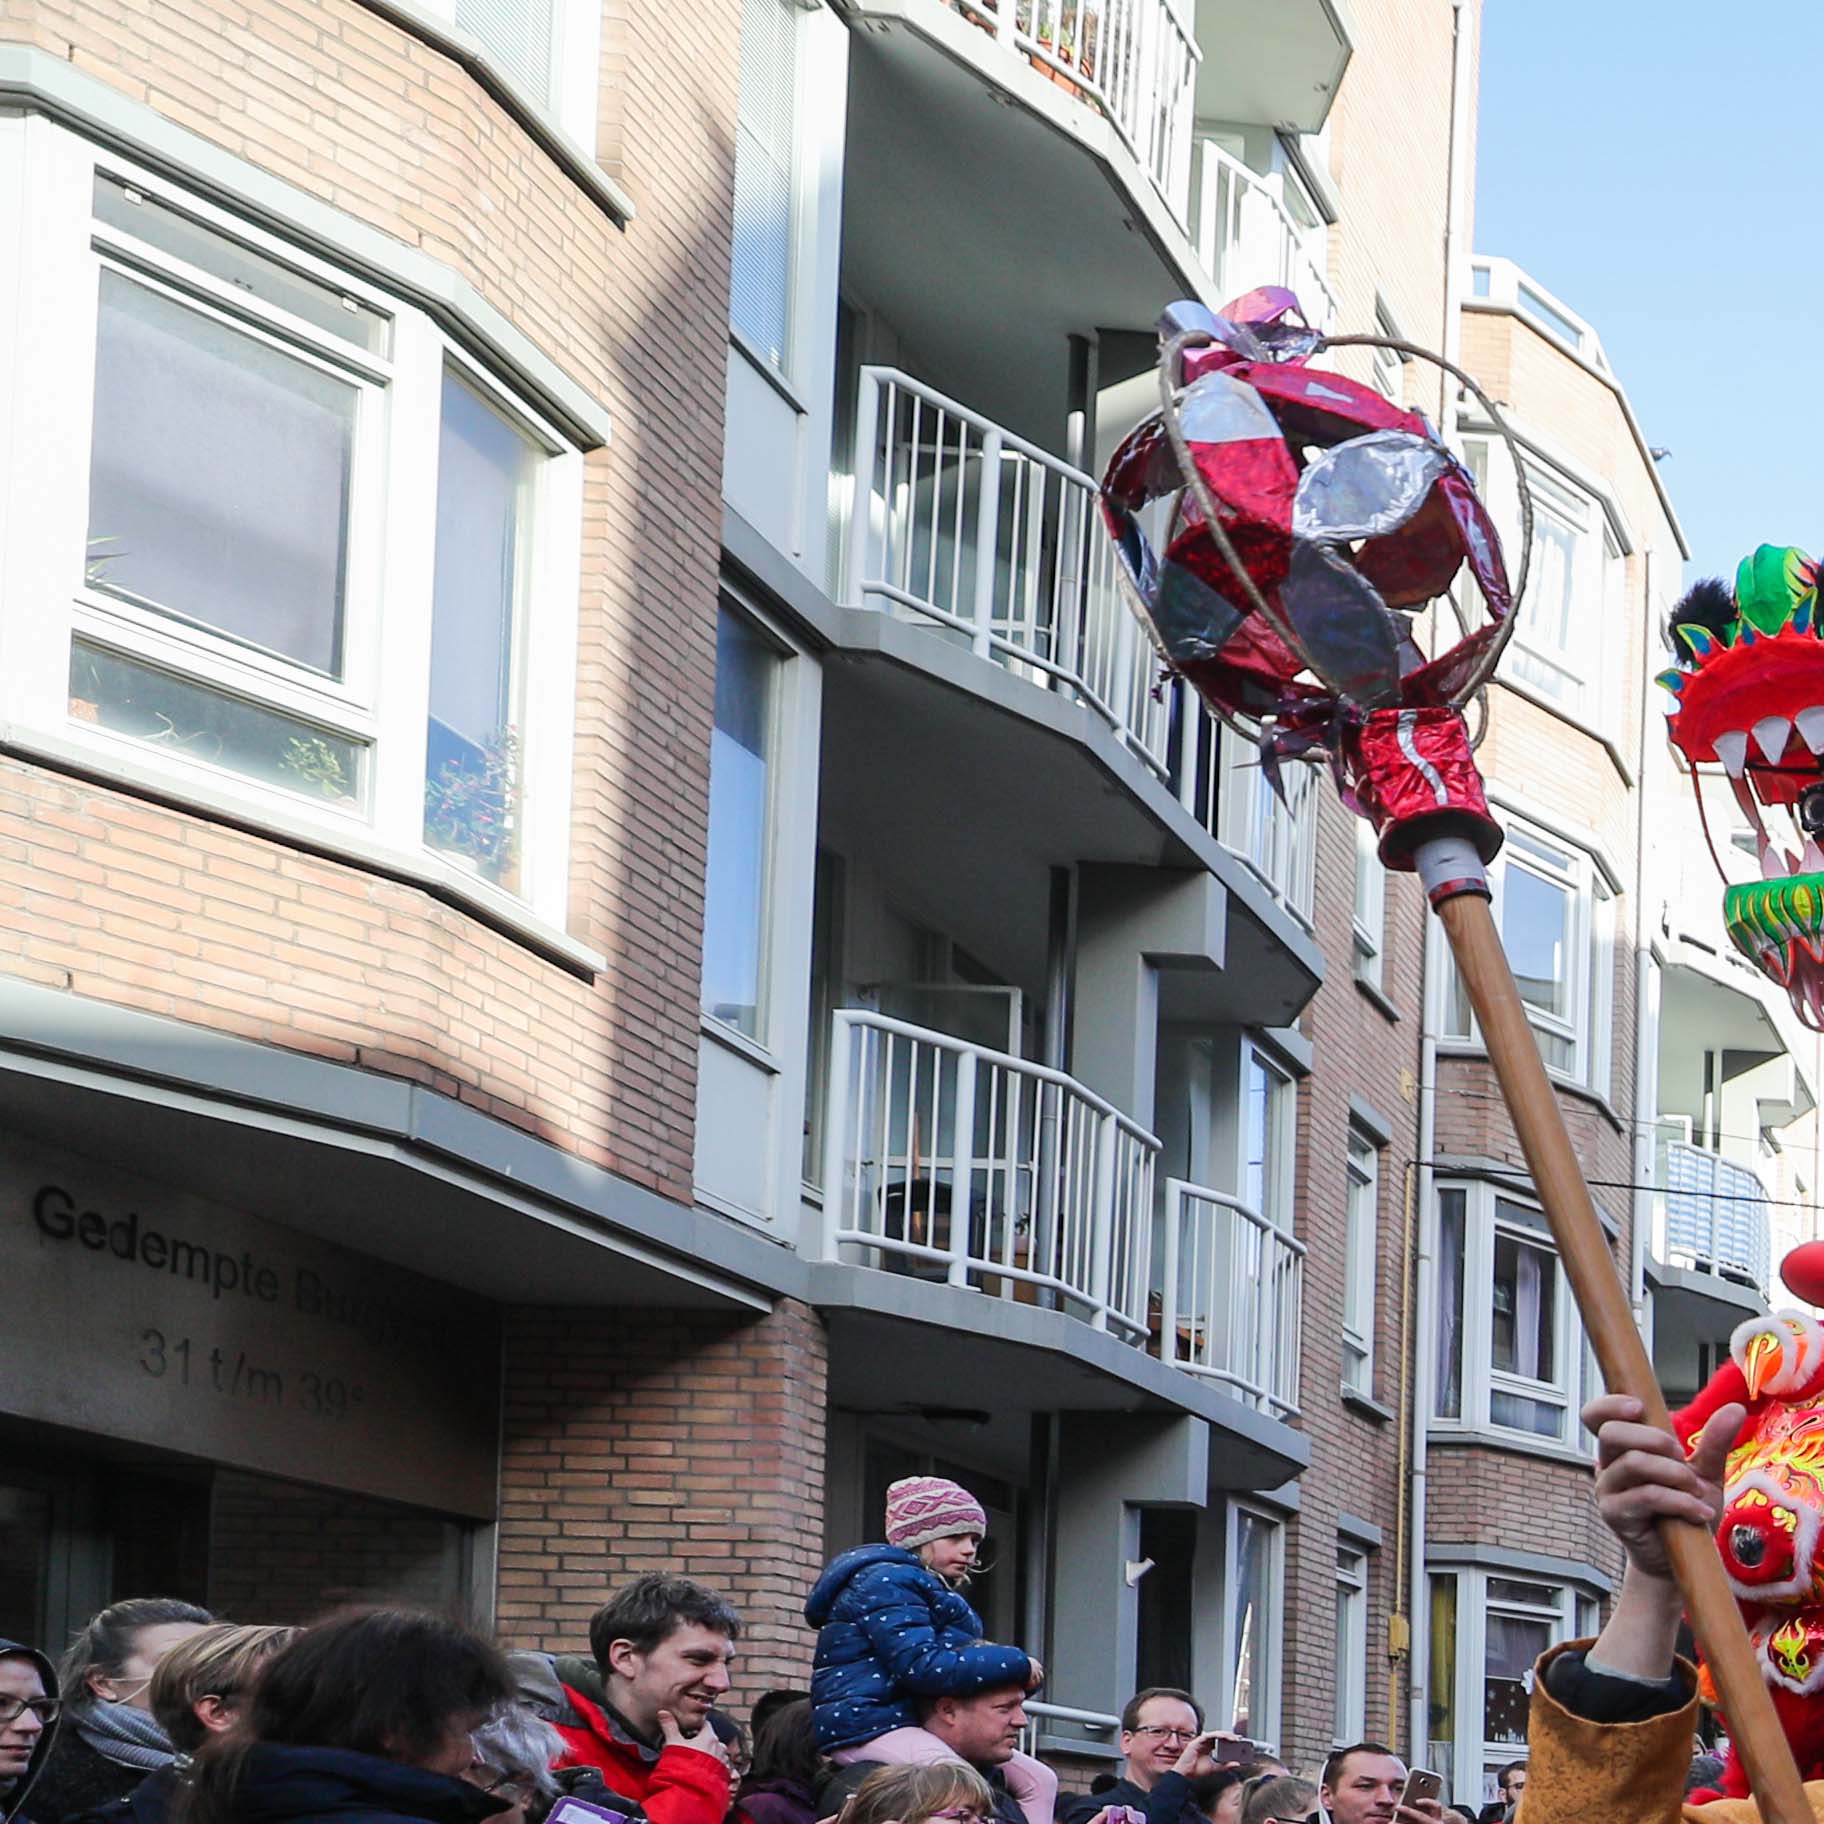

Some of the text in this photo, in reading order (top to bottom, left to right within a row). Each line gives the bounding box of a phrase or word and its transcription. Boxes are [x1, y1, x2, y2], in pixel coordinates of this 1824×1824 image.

[32, 1185, 280, 1299] Gedempte
[138, 1327, 191, 1385] 31
[208, 1347, 283, 1407] t/m
